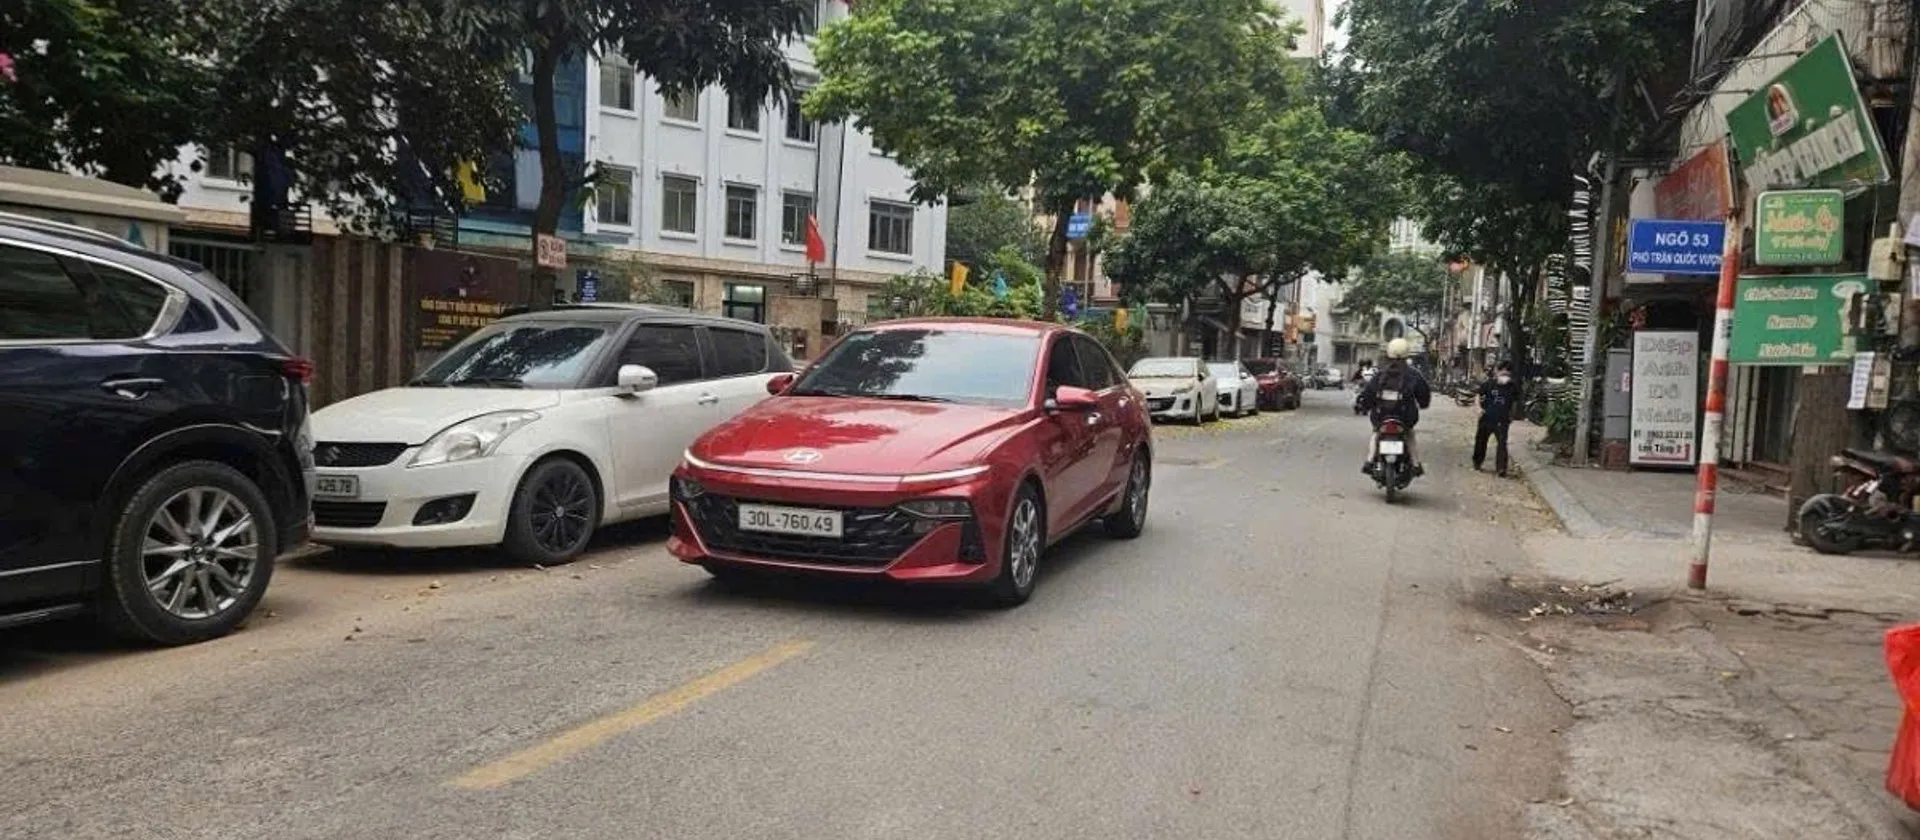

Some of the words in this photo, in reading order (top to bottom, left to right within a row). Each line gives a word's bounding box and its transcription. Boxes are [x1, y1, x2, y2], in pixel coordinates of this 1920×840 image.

[1655, 229, 1689, 247] NGÕ
[1692, 233, 1709, 247] 53
[1632, 251, 1649, 264] PHỐ
[1651, 249, 1672, 264] TRẦN
[1673, 249, 1697, 265] QUỐC
[747, 510, 833, 532] 30L-760.49
